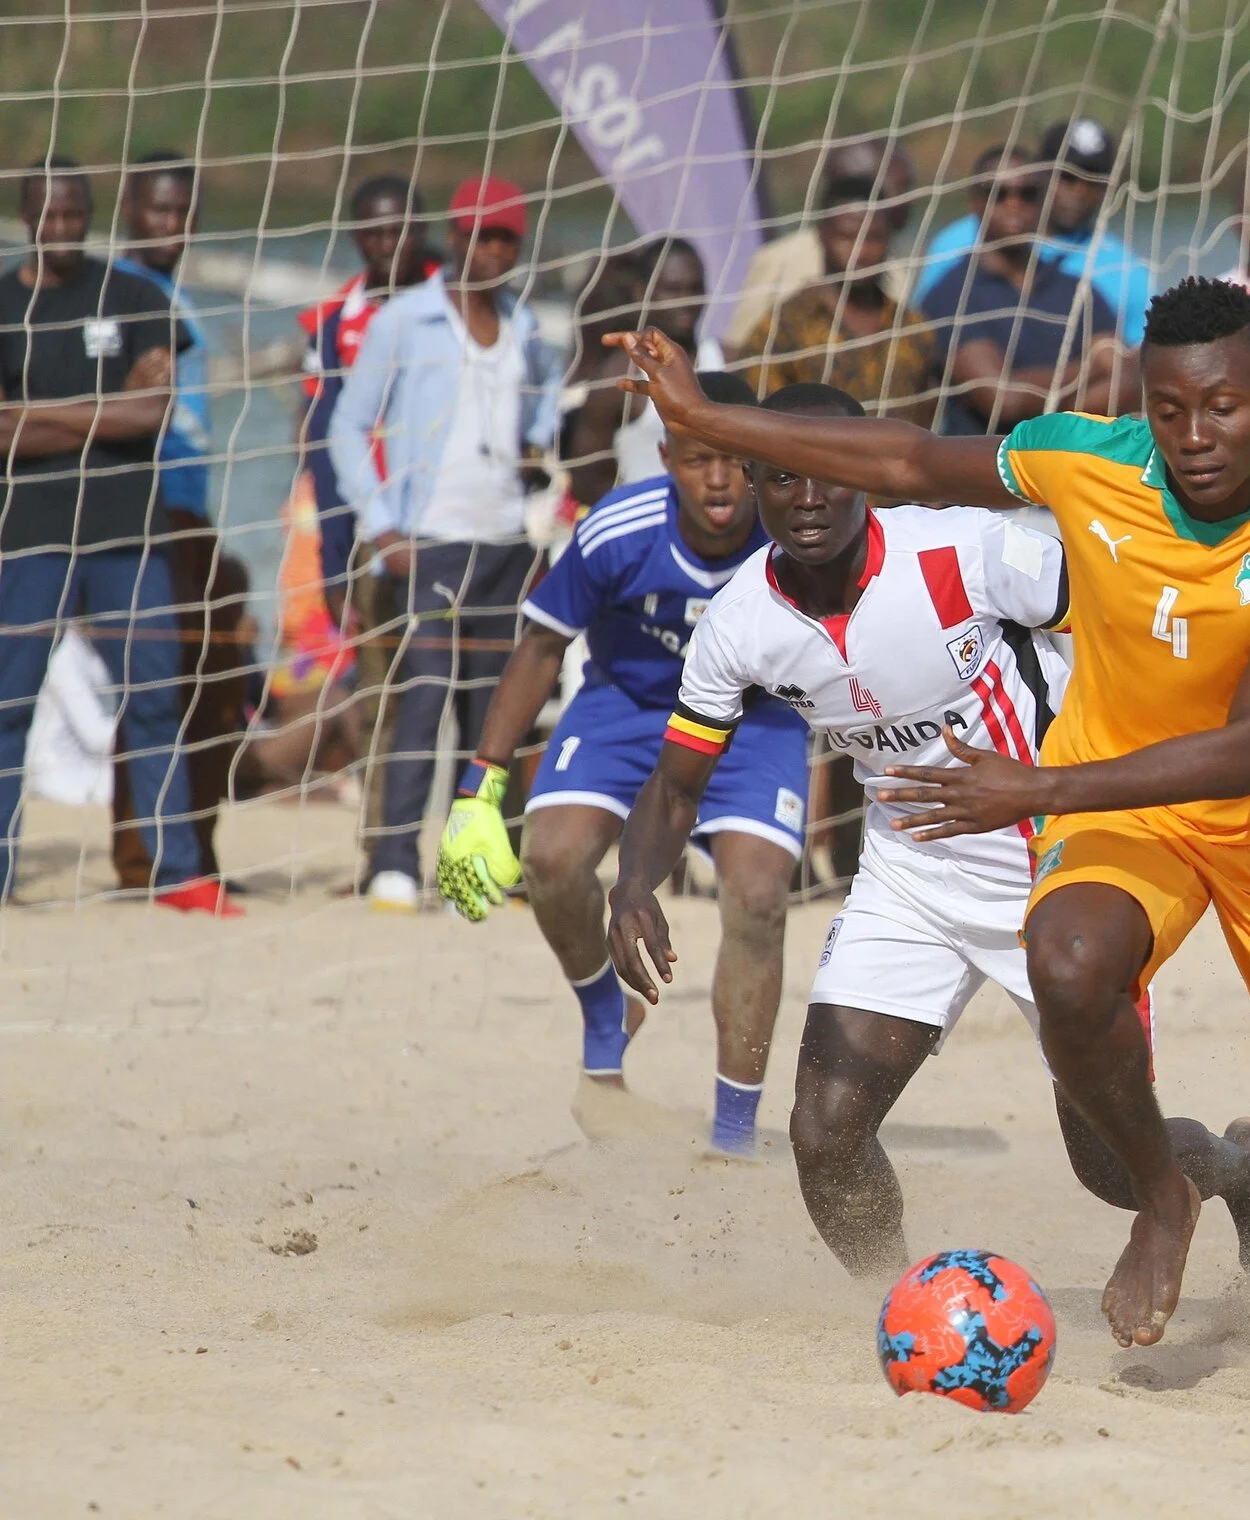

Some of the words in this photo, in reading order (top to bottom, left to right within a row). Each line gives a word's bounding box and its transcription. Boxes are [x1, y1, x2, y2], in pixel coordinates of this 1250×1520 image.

[1151, 585, 1188, 659] 4
[848, 677, 883, 719] 4
[826, 709, 968, 753] UGANDA
[554, 735, 581, 772] 1
